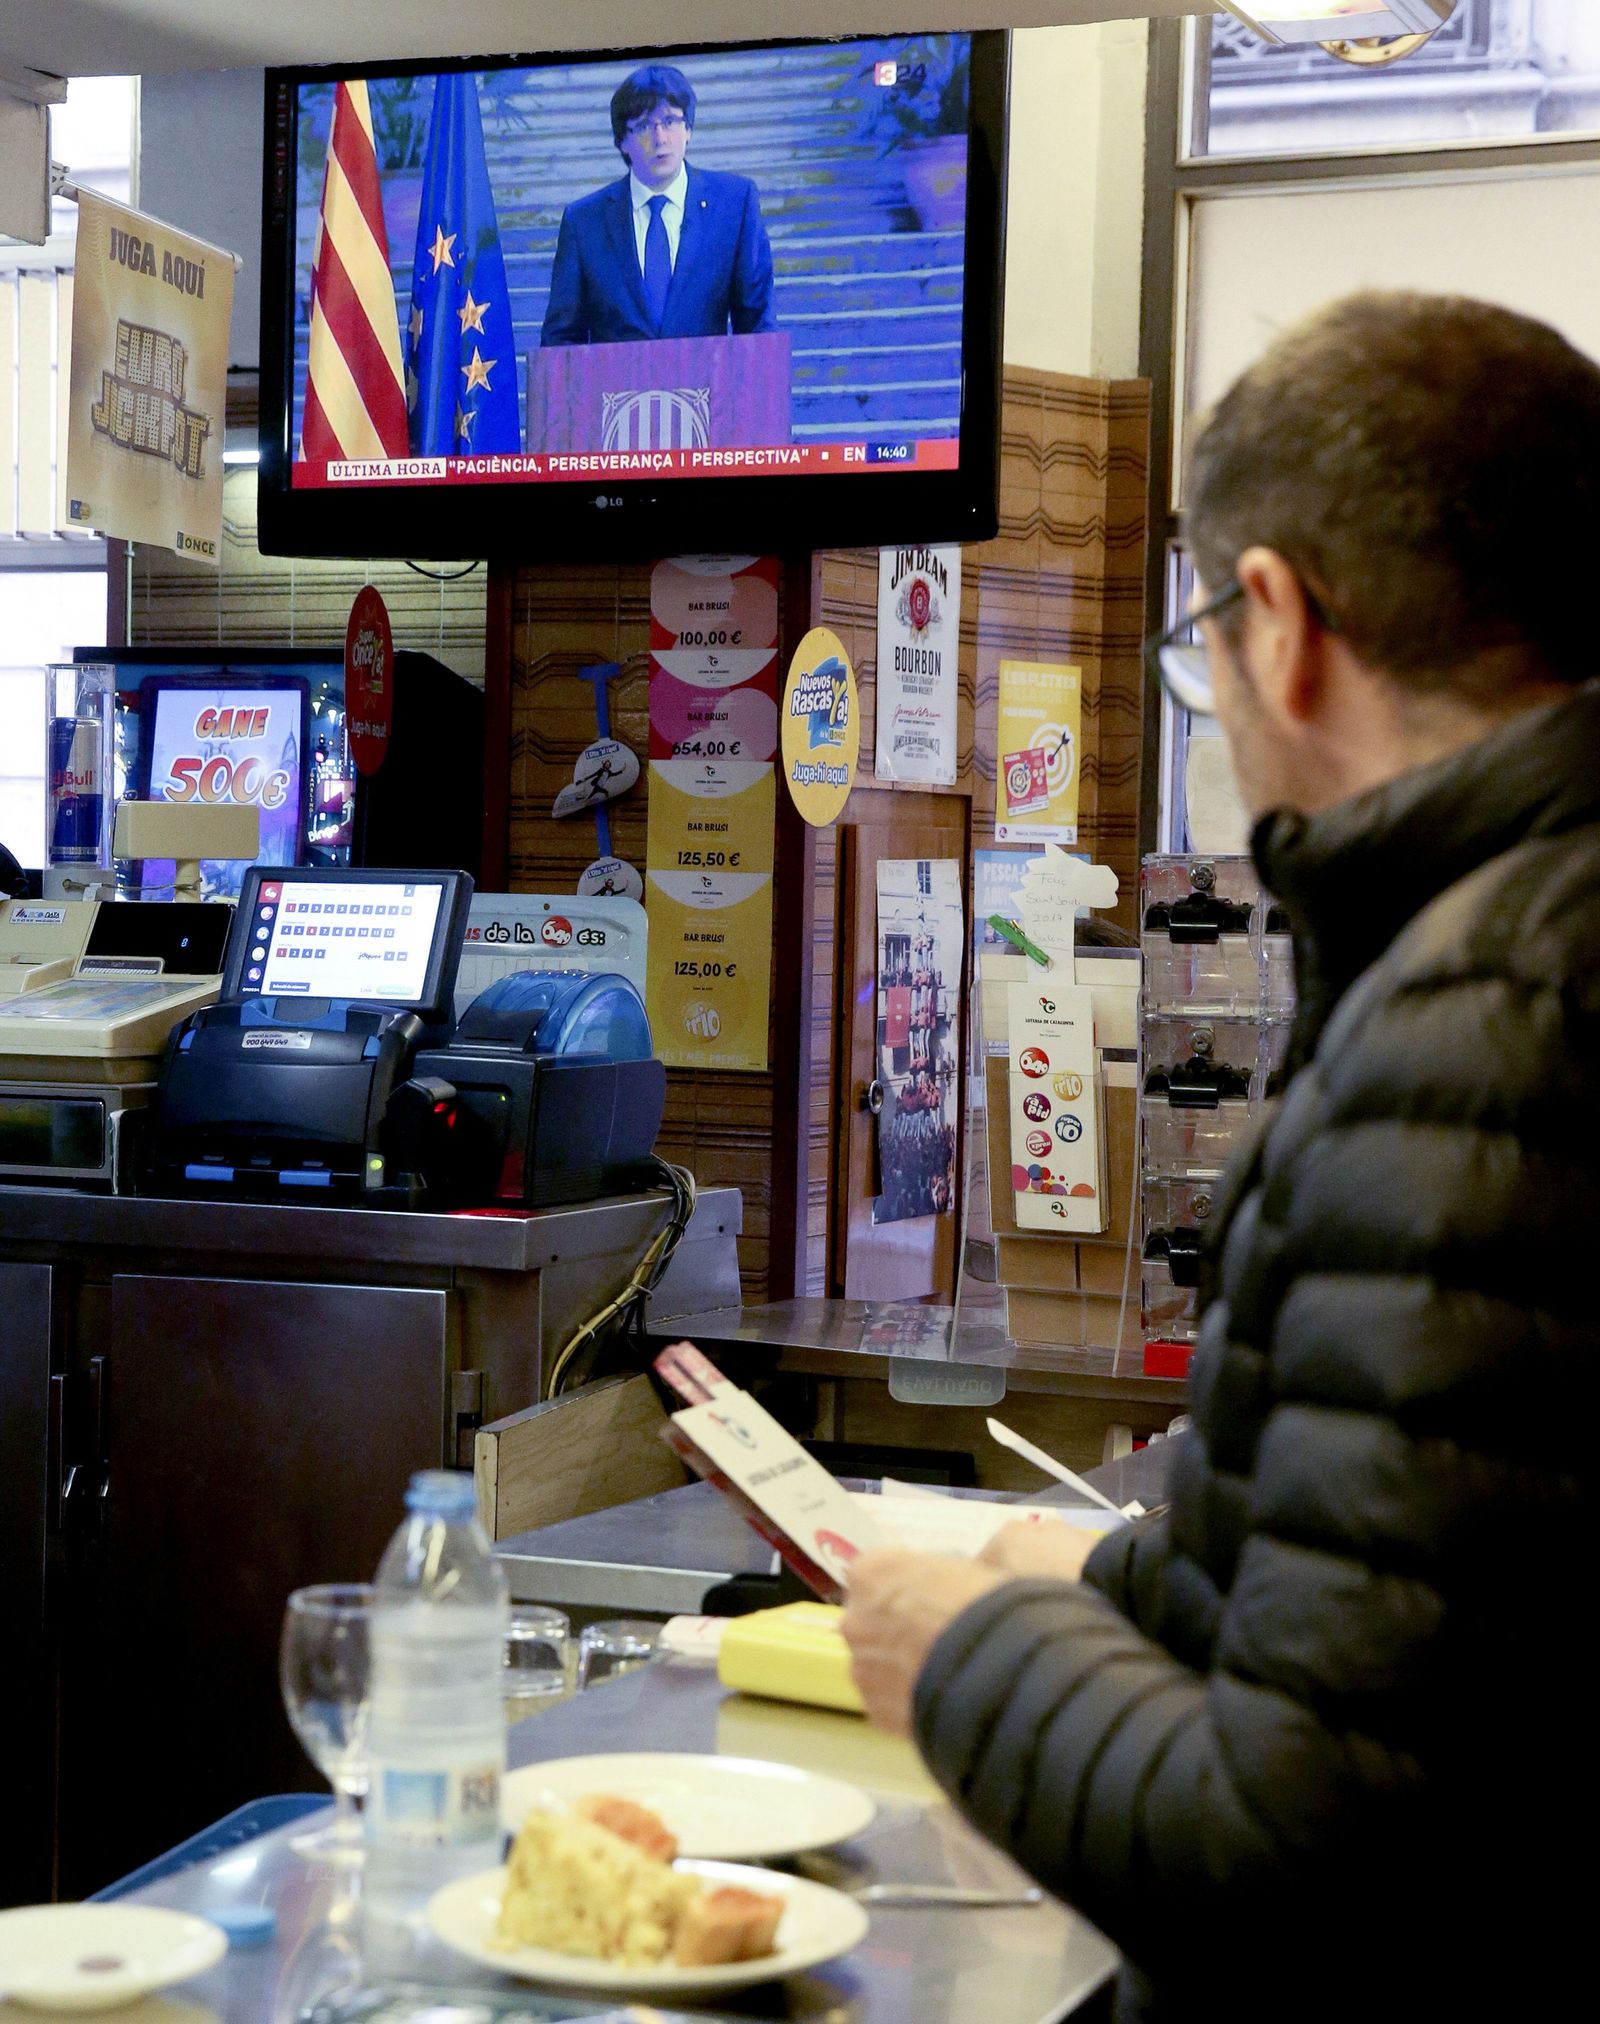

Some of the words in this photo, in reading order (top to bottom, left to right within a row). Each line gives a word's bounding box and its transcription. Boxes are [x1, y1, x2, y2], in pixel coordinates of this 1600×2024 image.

[109, 226, 157, 278] JUGA
[162, 250, 205, 300] AQUÍ
[115, 319, 187, 402] EURO
[332, 461, 394, 477] ÚLTIMA
[398, 460, 442, 475] HORA
[549, 452, 673, 472] PERSEVERANÇA
[681, 454, 685, 467] I
[844, 447, 866, 462] EN
[876, 446, 907, 460] 14:40
[610, 497, 624, 507] LG
[184, 536, 216, 557] ONCE
[891, 549, 914, 590] JIM
[688, 602, 704, 611] BAR
[706, 602, 730, 611] BRUSI
[679, 630, 727, 646] 100,00
[730, 630, 742, 645] €
[895, 646, 941, 676] BOURBON
[800, 674, 832, 692] Nuevos
[791, 688, 833, 717] Rascas
[195, 707, 270, 740] GANE
[687, 712, 703, 721] BAR
[705, 712, 729, 721] BRUSI
[672, 741, 726, 756] 654,00
[729, 741, 741, 756] €
[64, 769, 93, 786] Bull
[164, 757, 289, 807] 500€
[792, 760, 826, 786] Juga-hi
[687, 823, 703, 832] BAR
[704, 823, 729, 832] BRUSI
[677, 851, 726, 868] 125,50
[729, 851, 741, 867] €
[485, 922, 510, 943] de
[515, 923, 535, 943] la
[684, 933, 700, 942] BAR
[701, 934, 725, 943] BRUSI
[674, 962, 722, 978] 125,00
[725, 963, 737, 977] €
